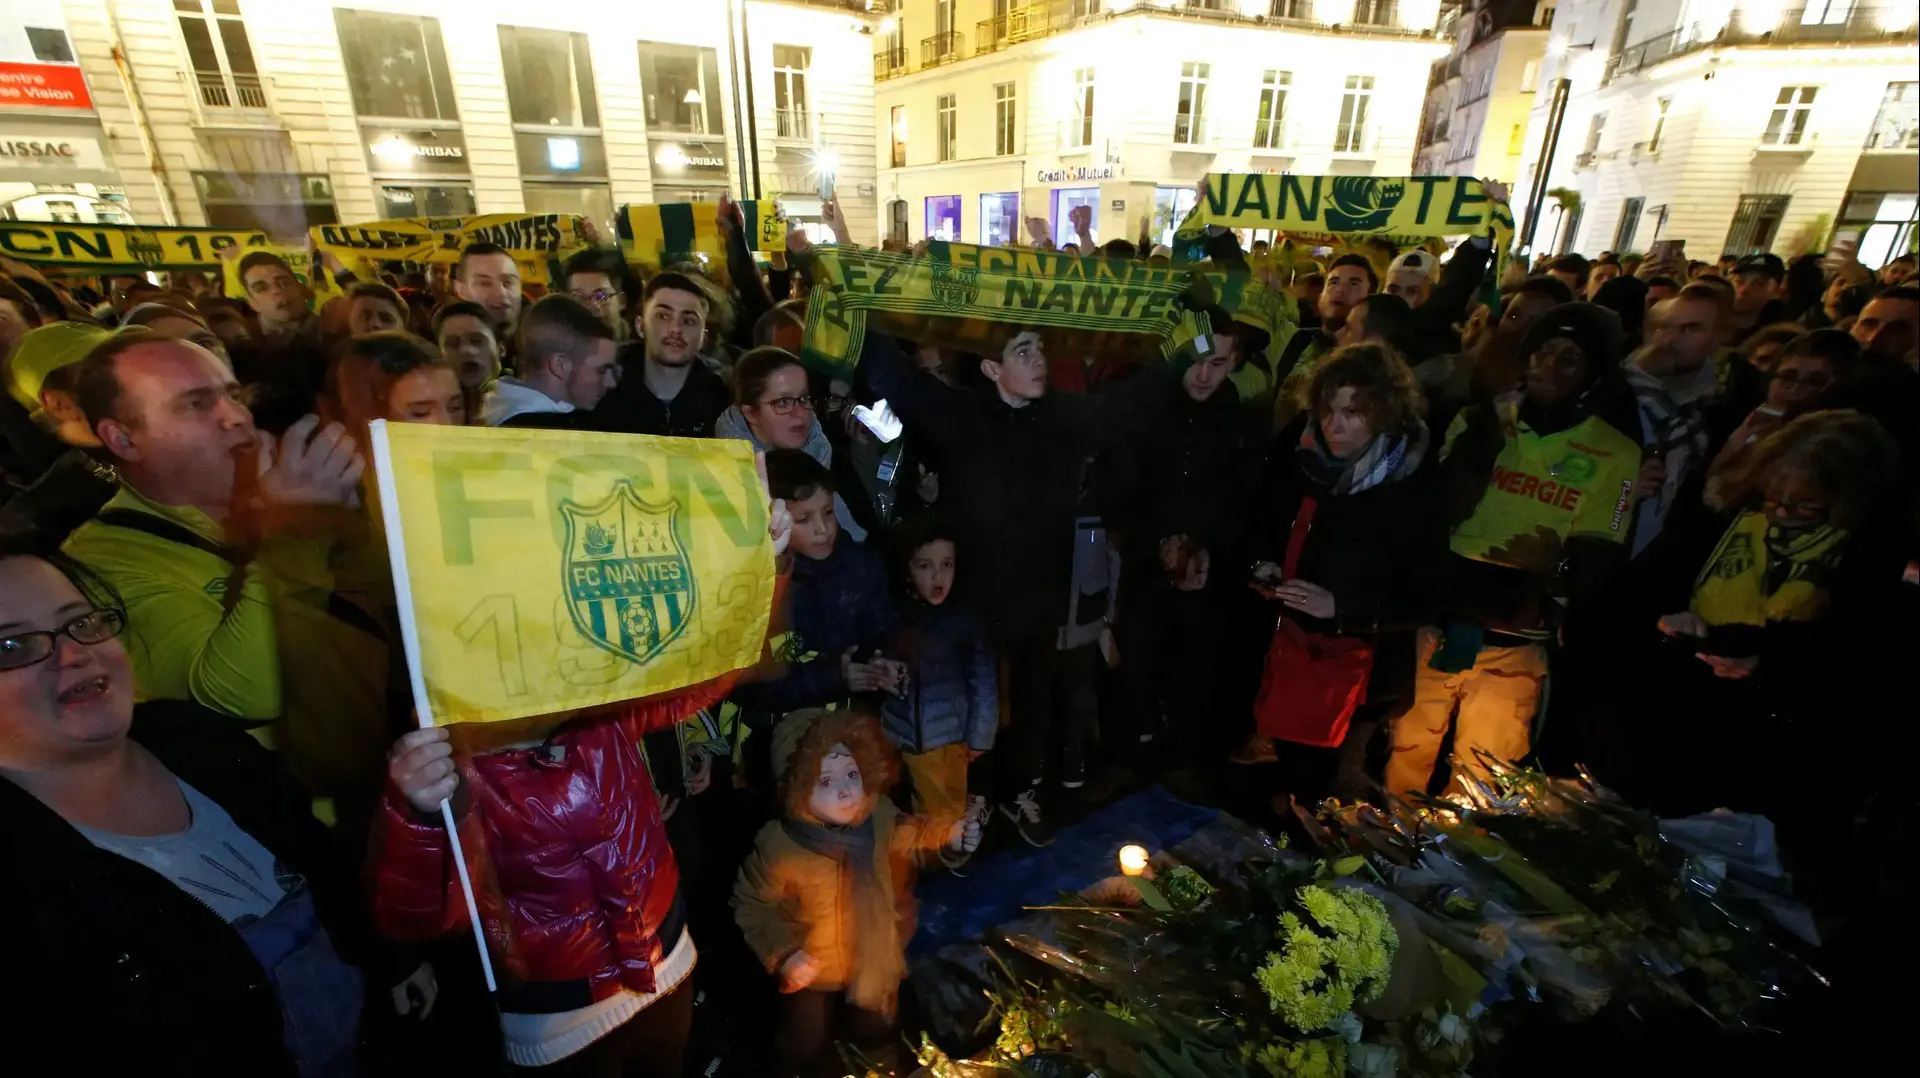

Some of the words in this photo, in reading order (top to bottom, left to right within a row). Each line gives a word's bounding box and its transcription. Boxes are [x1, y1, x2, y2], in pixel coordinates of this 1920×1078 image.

[22, 86, 75, 100] Vision
[408, 145, 462, 157] ARIBAS
[681, 156, 724, 167] ARIBAS
[1077, 165, 1114, 180] Mutuel
[474, 214, 561, 251] NANTES
[0, 228, 114, 259] CN
[175, 234, 265, 261] 19
[431, 449, 769, 566] FCN
[572, 565, 601, 587] FC
[604, 560, 682, 584] NANTES
